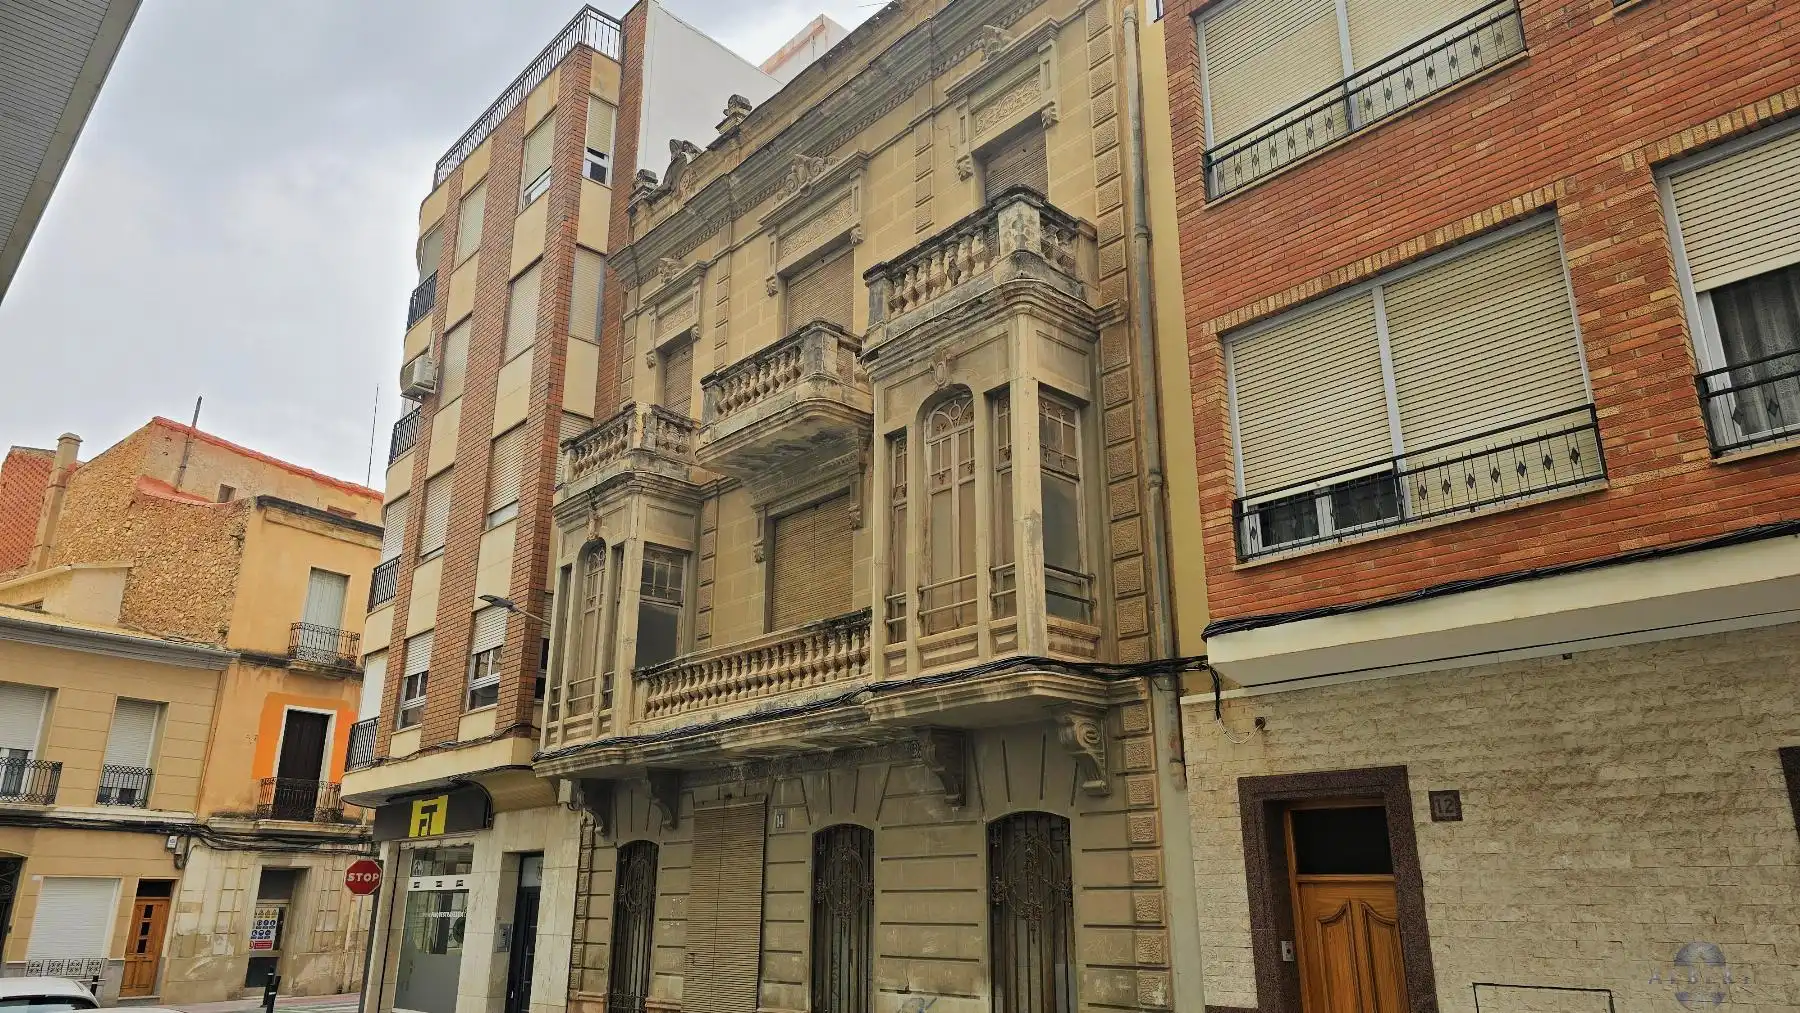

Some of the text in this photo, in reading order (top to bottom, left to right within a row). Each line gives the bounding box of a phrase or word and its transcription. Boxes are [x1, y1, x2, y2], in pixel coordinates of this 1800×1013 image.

[1433, 794, 1457, 817] 12
[776, 814, 784, 828] 14
[347, 872, 379, 882] STOP
